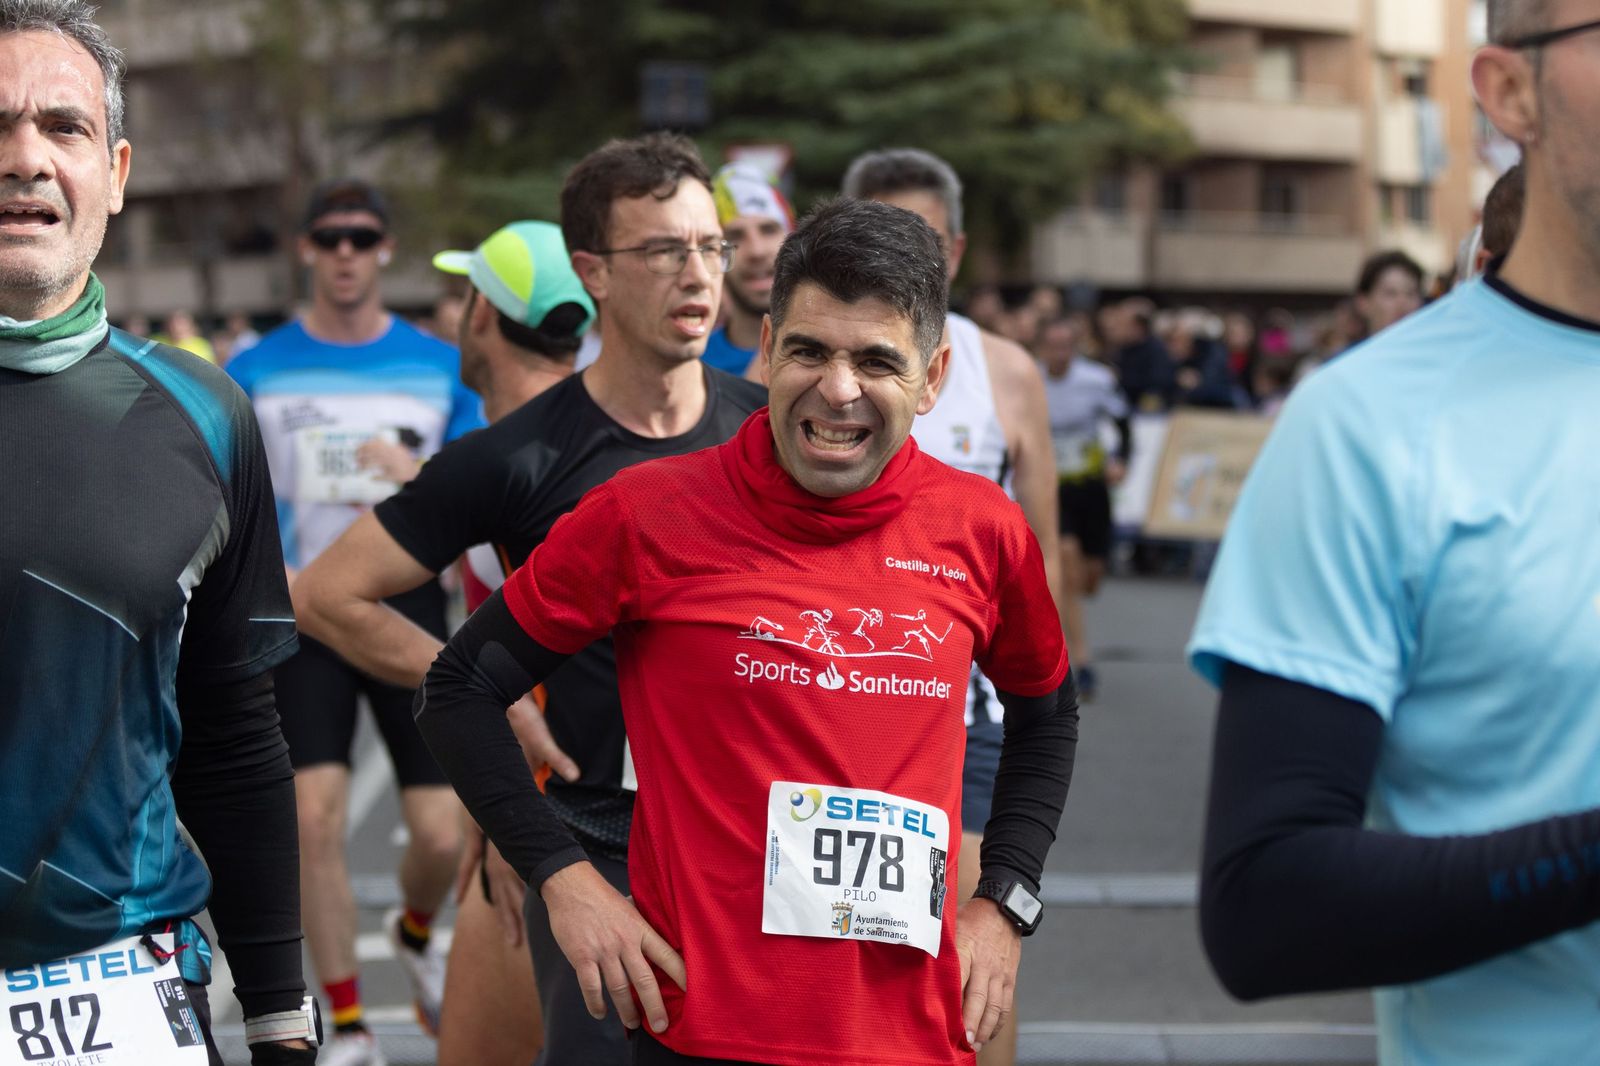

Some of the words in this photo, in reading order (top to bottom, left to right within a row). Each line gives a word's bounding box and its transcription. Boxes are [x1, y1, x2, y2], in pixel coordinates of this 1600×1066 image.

[885, 557, 930, 573] Castilla
[932, 564, 940, 576] y
[942, 565, 967, 582] León
[734, 653, 811, 686] Sports
[849, 671, 951, 699] Santander
[826, 796, 936, 839] SETEL
[813, 828, 904, 893] 978
[843, 889, 877, 902] PILO
[854, 926, 864, 936] de
[855, 914, 909, 929] Ayuntamiento
[6, 949, 155, 993] SETEL
[174, 985, 186, 1001] 812
[9, 993, 113, 1061] 812
